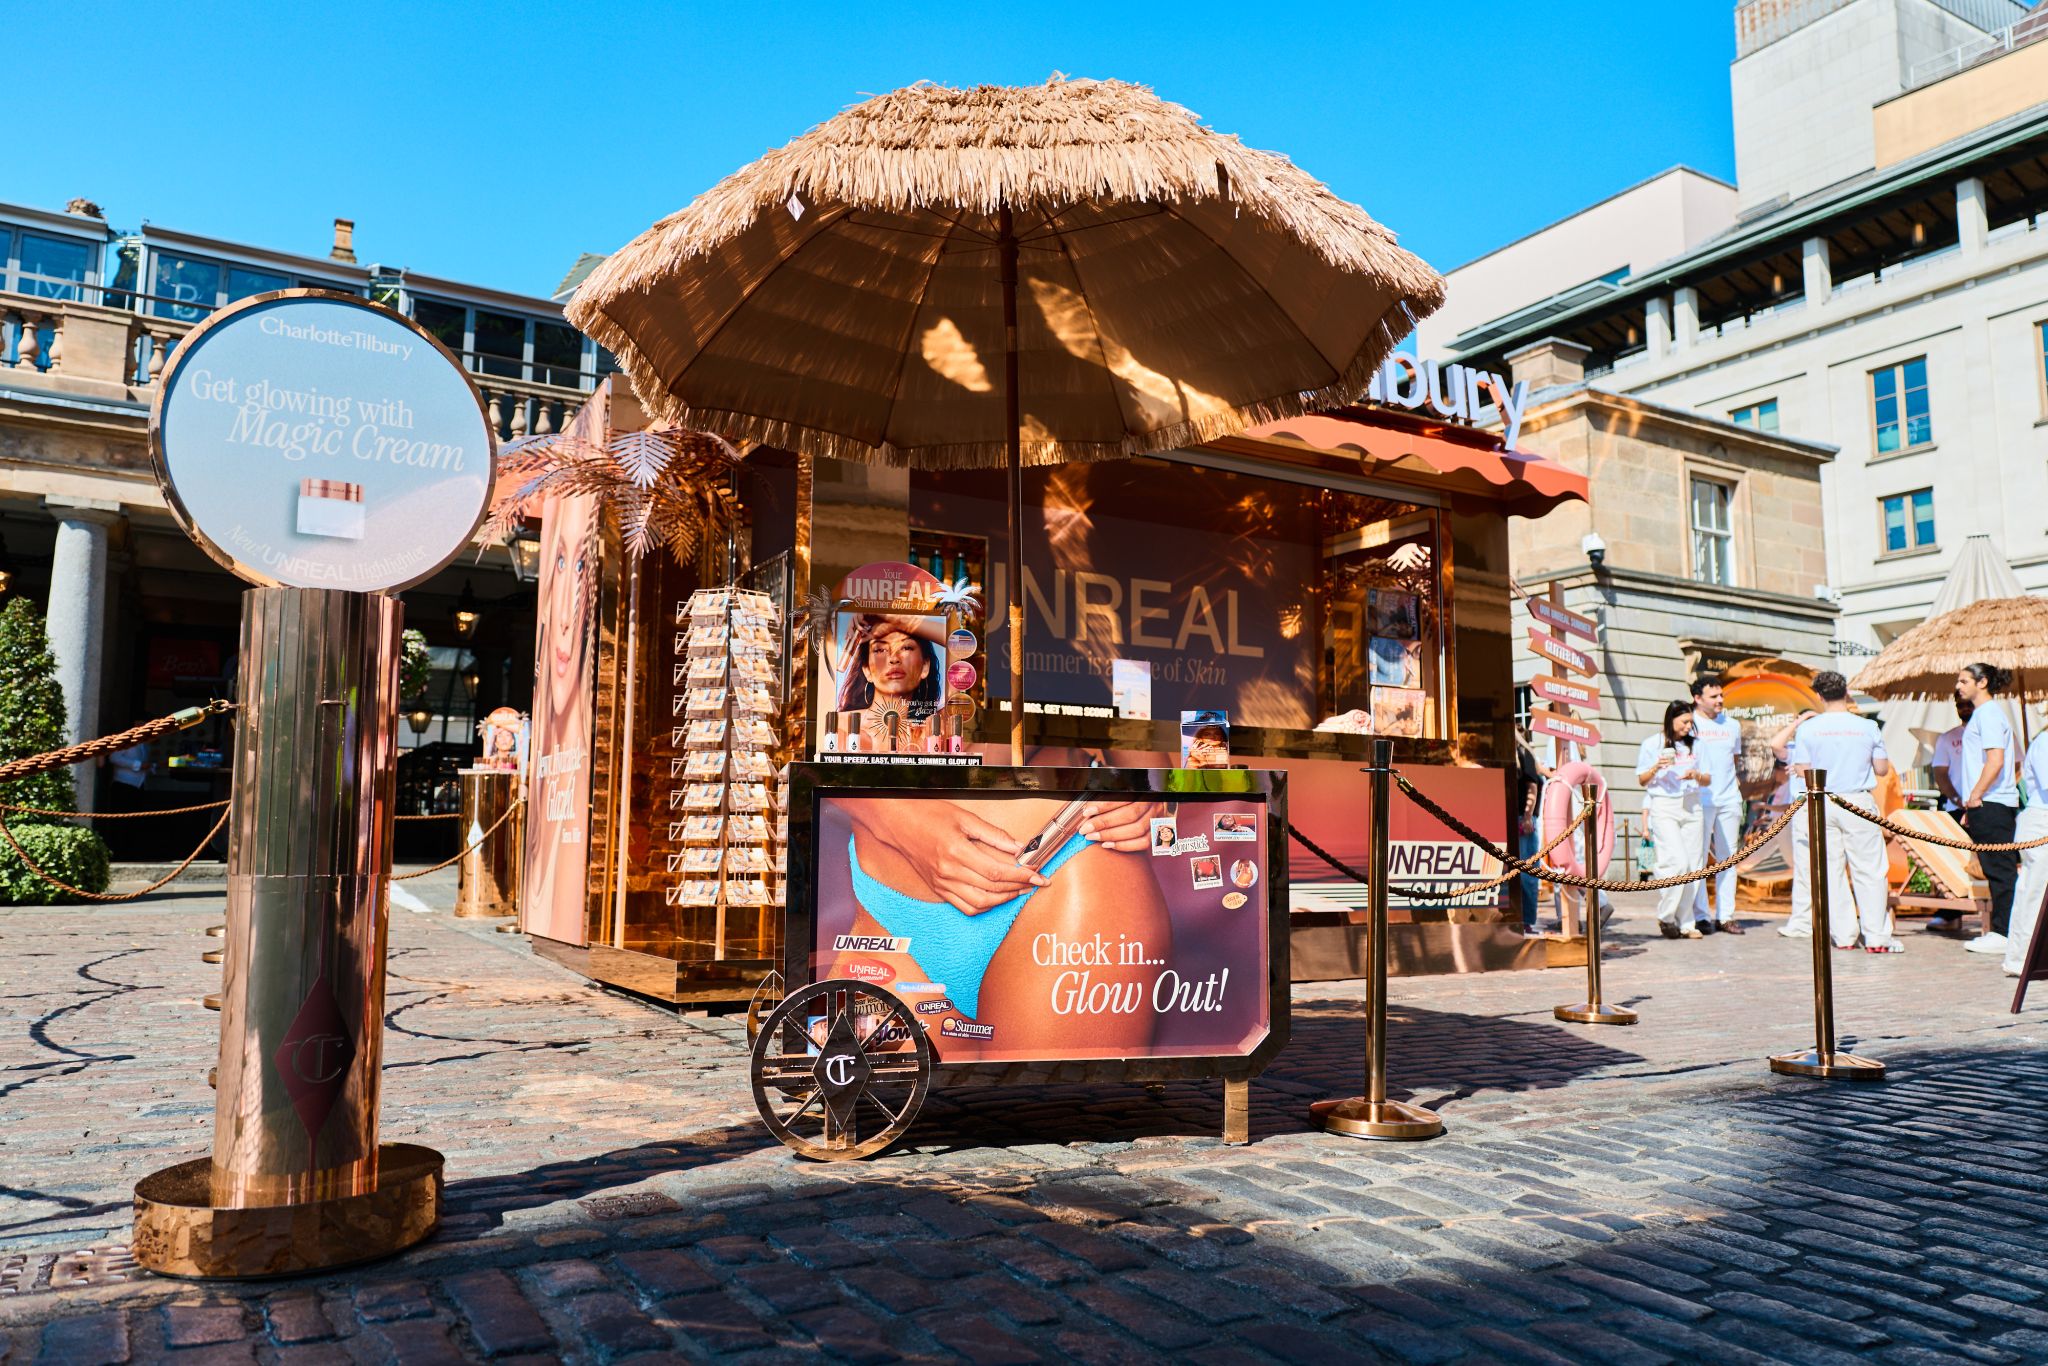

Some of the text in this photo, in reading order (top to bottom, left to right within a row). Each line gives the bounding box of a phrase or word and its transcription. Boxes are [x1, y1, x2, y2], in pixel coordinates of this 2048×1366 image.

[259, 316, 413, 361] CharlotteTilbury
[190, 369, 415, 429] Get glowing with
[225, 405, 465, 472] Magic Cream
[262, 545, 351, 582] UNREAL
[352, 545, 428, 581] Highlighter
[882, 568, 902, 580] Your
[847, 577, 937, 603] UNREAL
[855, 597, 891, 609] Summer
[1001, 642, 1084, 676] Smmer
[1087, 650, 1101, 676] is
[1163, 661, 1183, 683] of
[1184, 663, 1227, 687] Skin
[1060, 705, 1084, 717] YOUR
[1756, 713, 1796, 727] UNRE
[824, 755, 842, 763] YOUR
[843, 756, 870, 764] SPEEDY,
[872, 756, 889, 764] EASY,
[890, 757, 917, 765] UNREAL
[918, 757, 947, 765] SUMMER
[967, 758, 980, 766] UP!
[835, 936, 896, 951] UNREAL
[1032, 933, 1165, 966] Check in...
[849, 964, 890, 977] UNREAL
[1051, 967, 1230, 1015] Glow Out!
[919, 1002, 950, 1012] UNREAL
[955, 1020, 993, 1035] Summer
